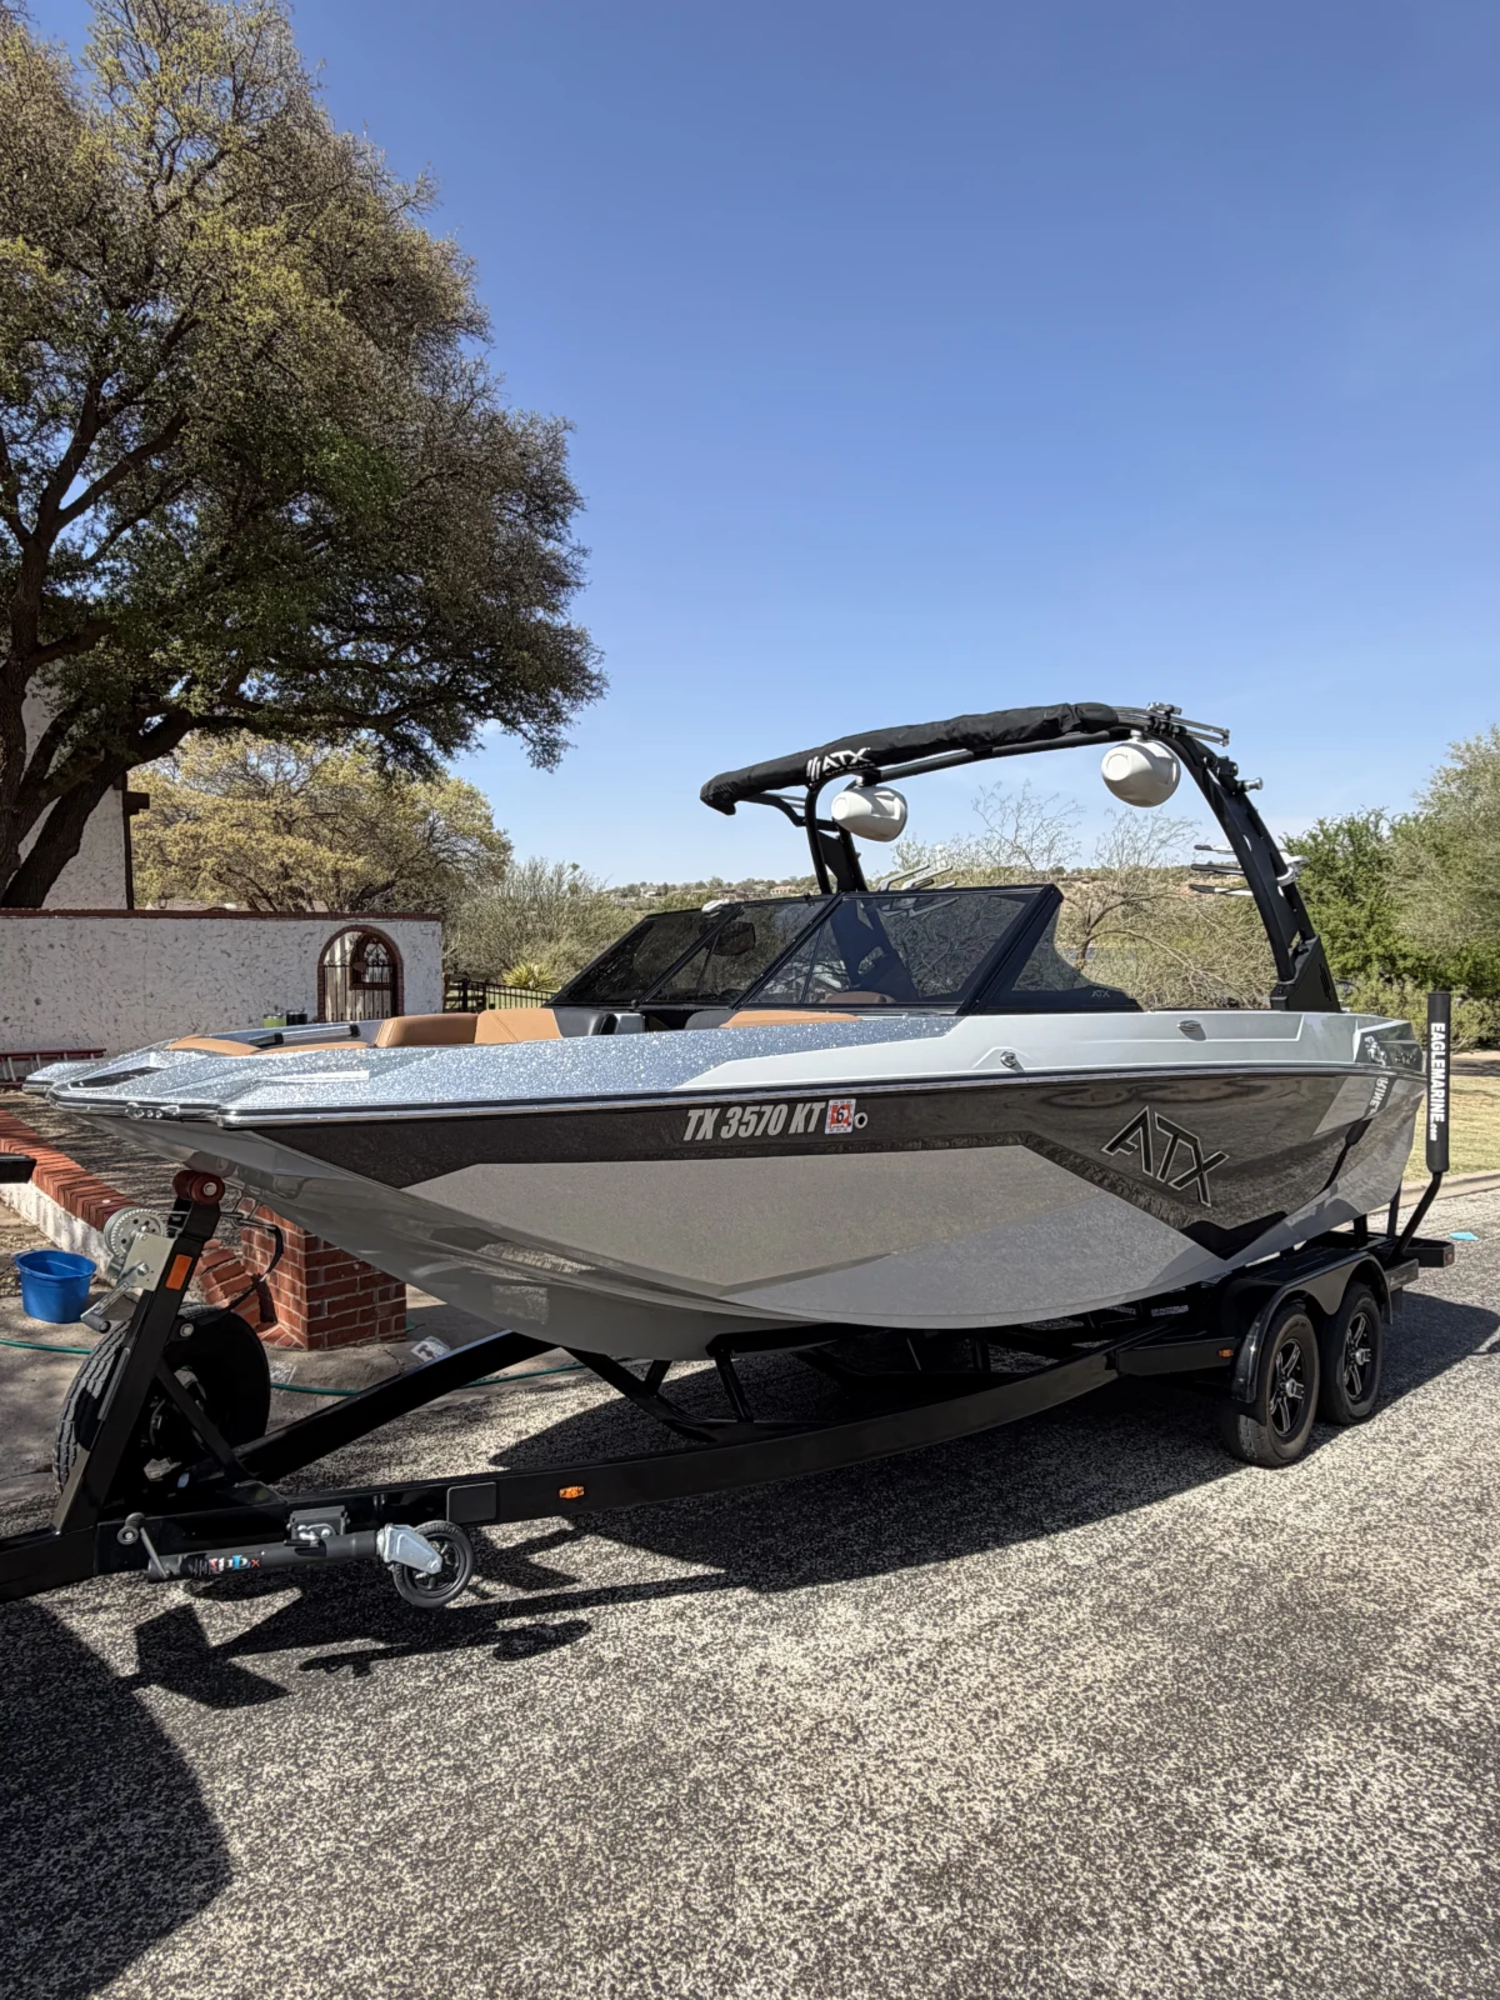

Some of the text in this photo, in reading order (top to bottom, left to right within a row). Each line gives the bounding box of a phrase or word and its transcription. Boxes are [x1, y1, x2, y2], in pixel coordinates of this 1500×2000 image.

[822, 747, 871, 772] ATX
[1091, 990, 1110, 998] ATX
[683, 1102, 826, 1141] TX 3570 KT
[1101, 1105, 1230, 1207] ATX
